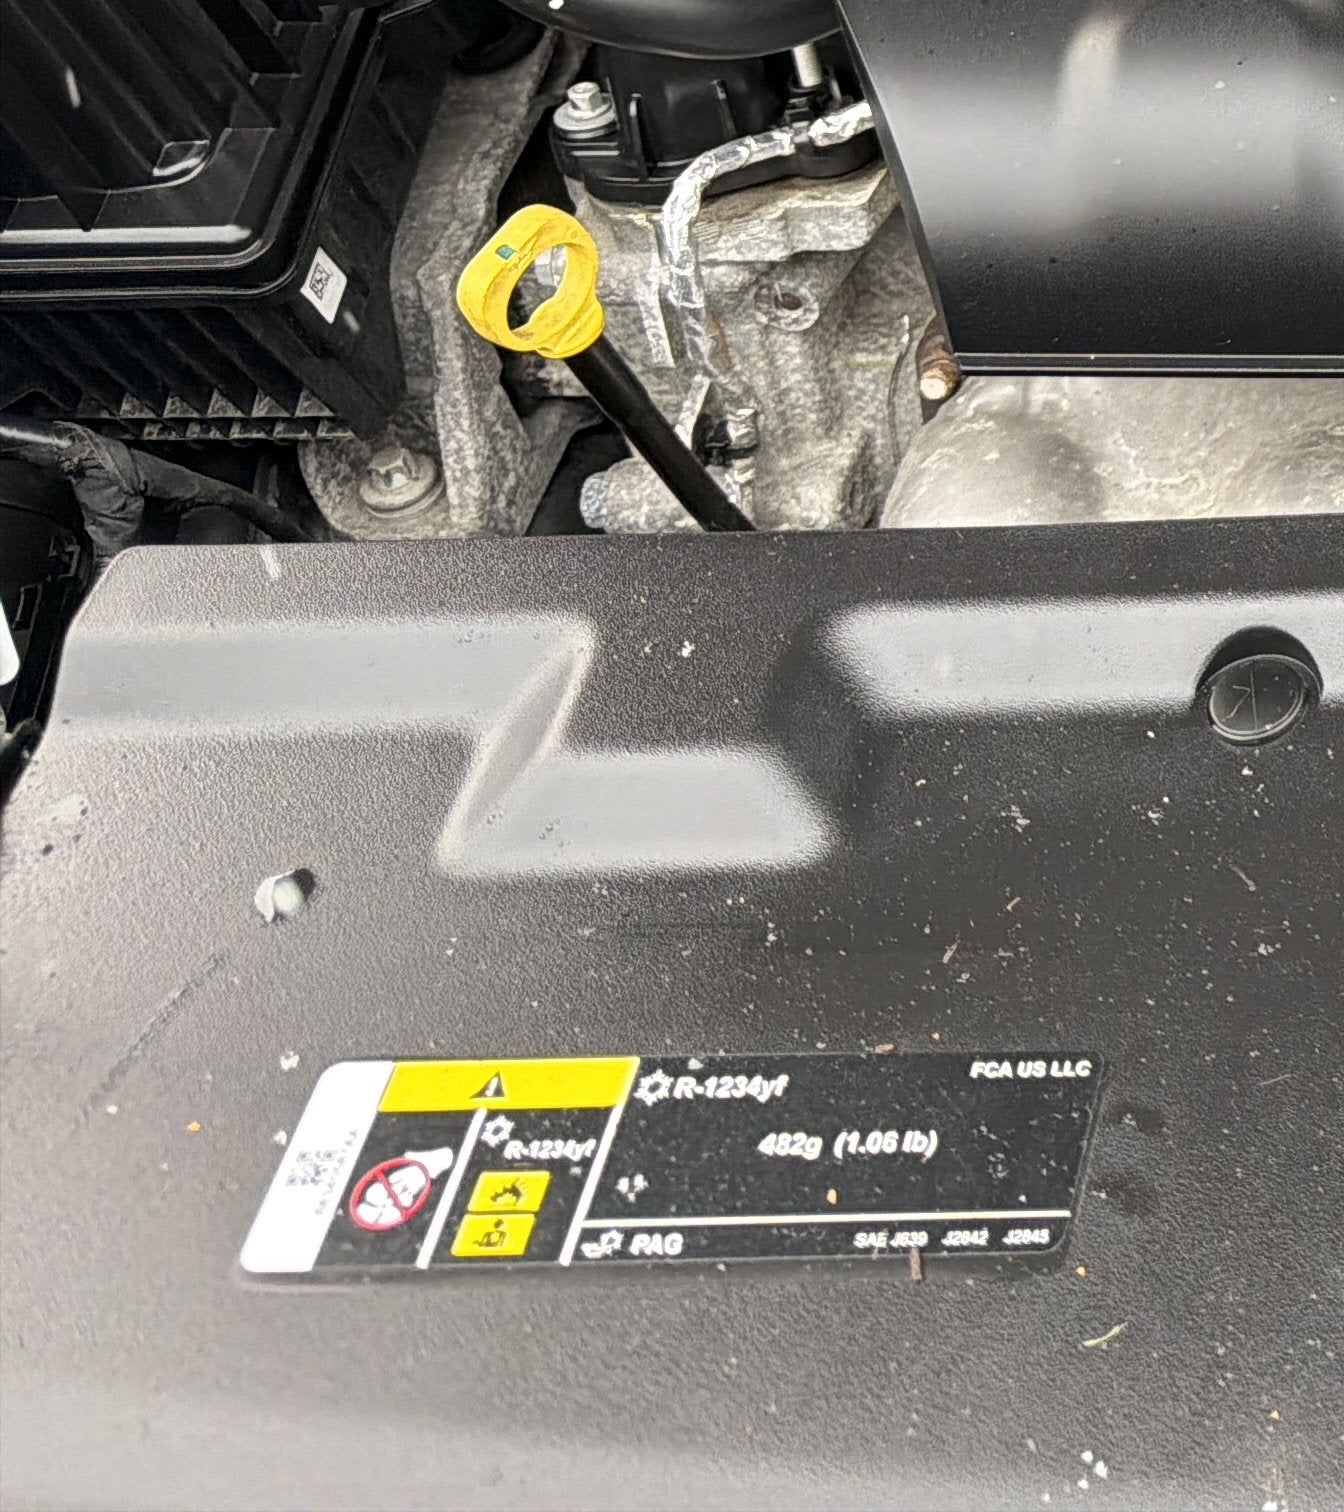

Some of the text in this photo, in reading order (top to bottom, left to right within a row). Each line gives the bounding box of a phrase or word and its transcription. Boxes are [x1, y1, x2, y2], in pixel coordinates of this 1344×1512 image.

[969, 1059, 1093, 1079] FCA US LLC
[673, 1073, 790, 1104] R-1234yf
[757, 1130, 938, 1161] 482g (1.06 lb)
[628, 1232, 685, 1257] PAG
[852, 1231, 888, 1249] SAE
